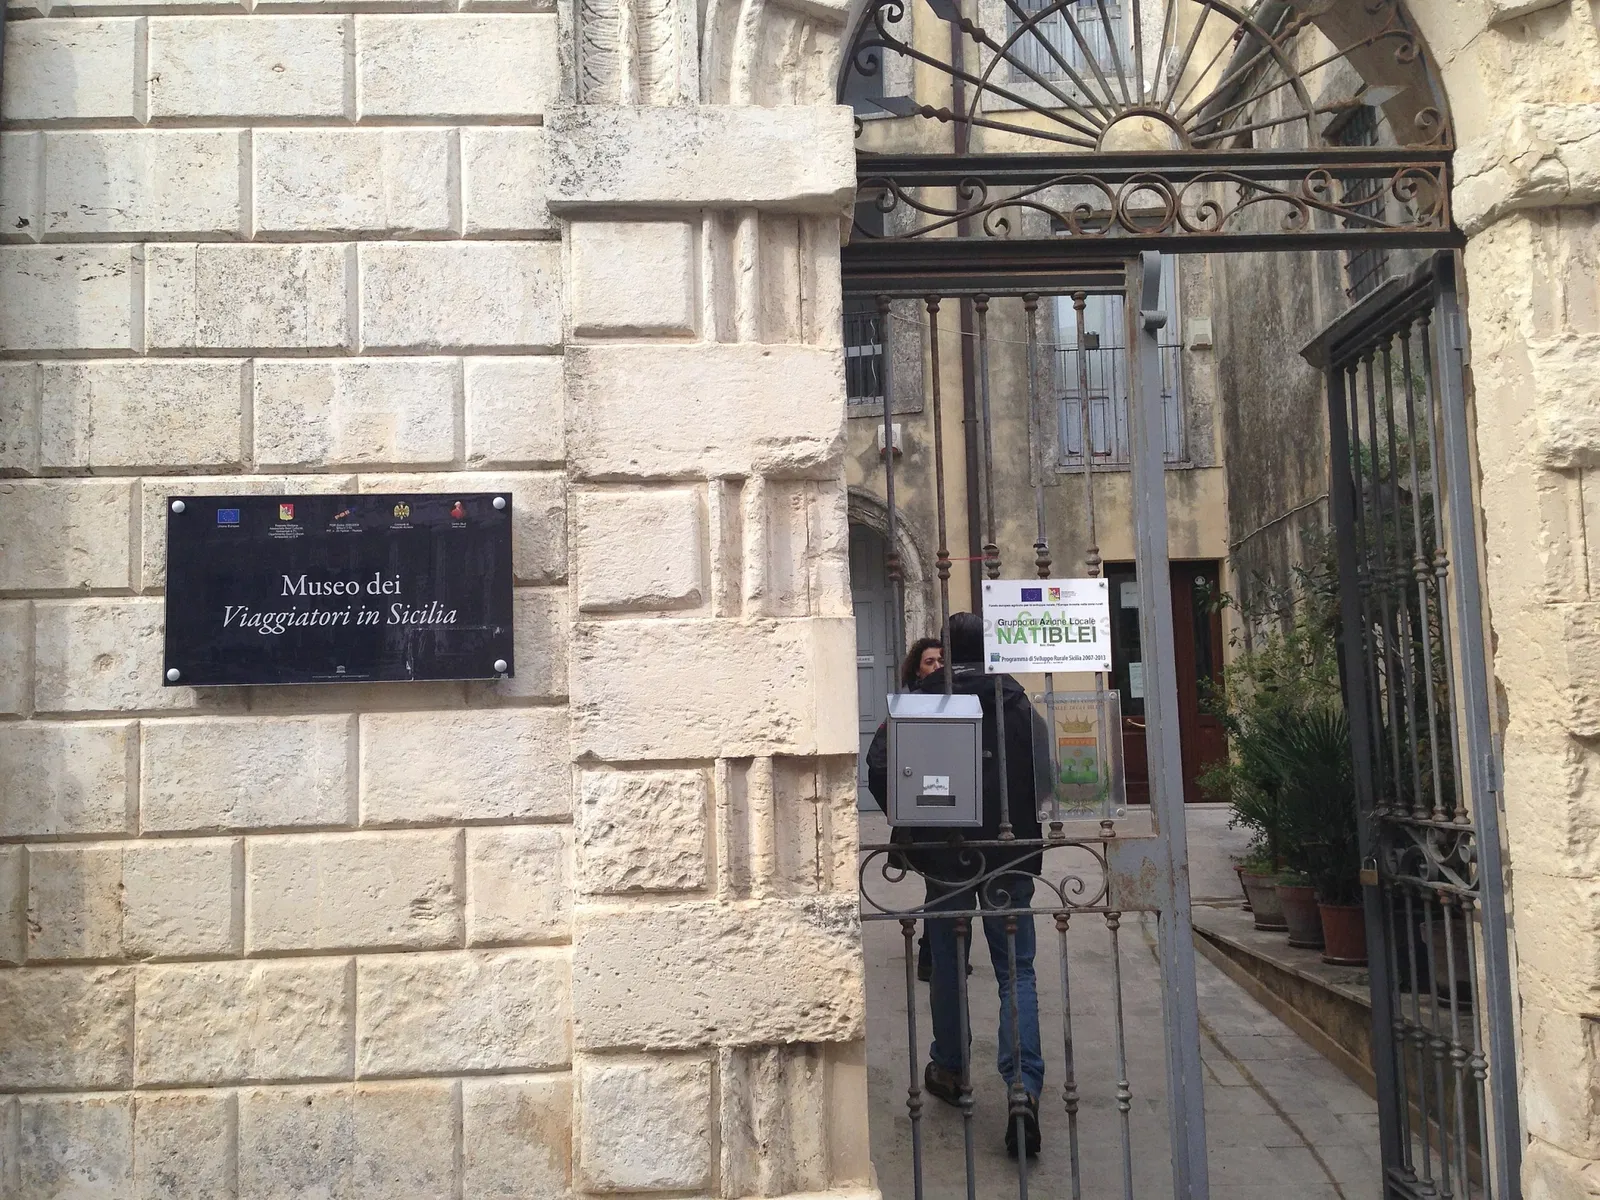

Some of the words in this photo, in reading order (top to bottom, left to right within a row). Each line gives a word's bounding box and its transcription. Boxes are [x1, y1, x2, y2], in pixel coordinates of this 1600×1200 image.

[281, 574, 360, 596] Museo
[366, 572, 402, 595] dei
[223, 605, 351, 635] Viaggiatori
[356, 605, 380, 625] in
[386, 601, 457, 625] Sicilia
[997, 618, 1028, 628] Gruppo
[1029, 618, 1038, 626] di
[1039, 617, 1067, 626] Azione
[1069, 617, 1096, 626] Locale
[997, 626, 1097, 644] NATIBLEI
[1034, 655, 1053, 663] Sviluppo
